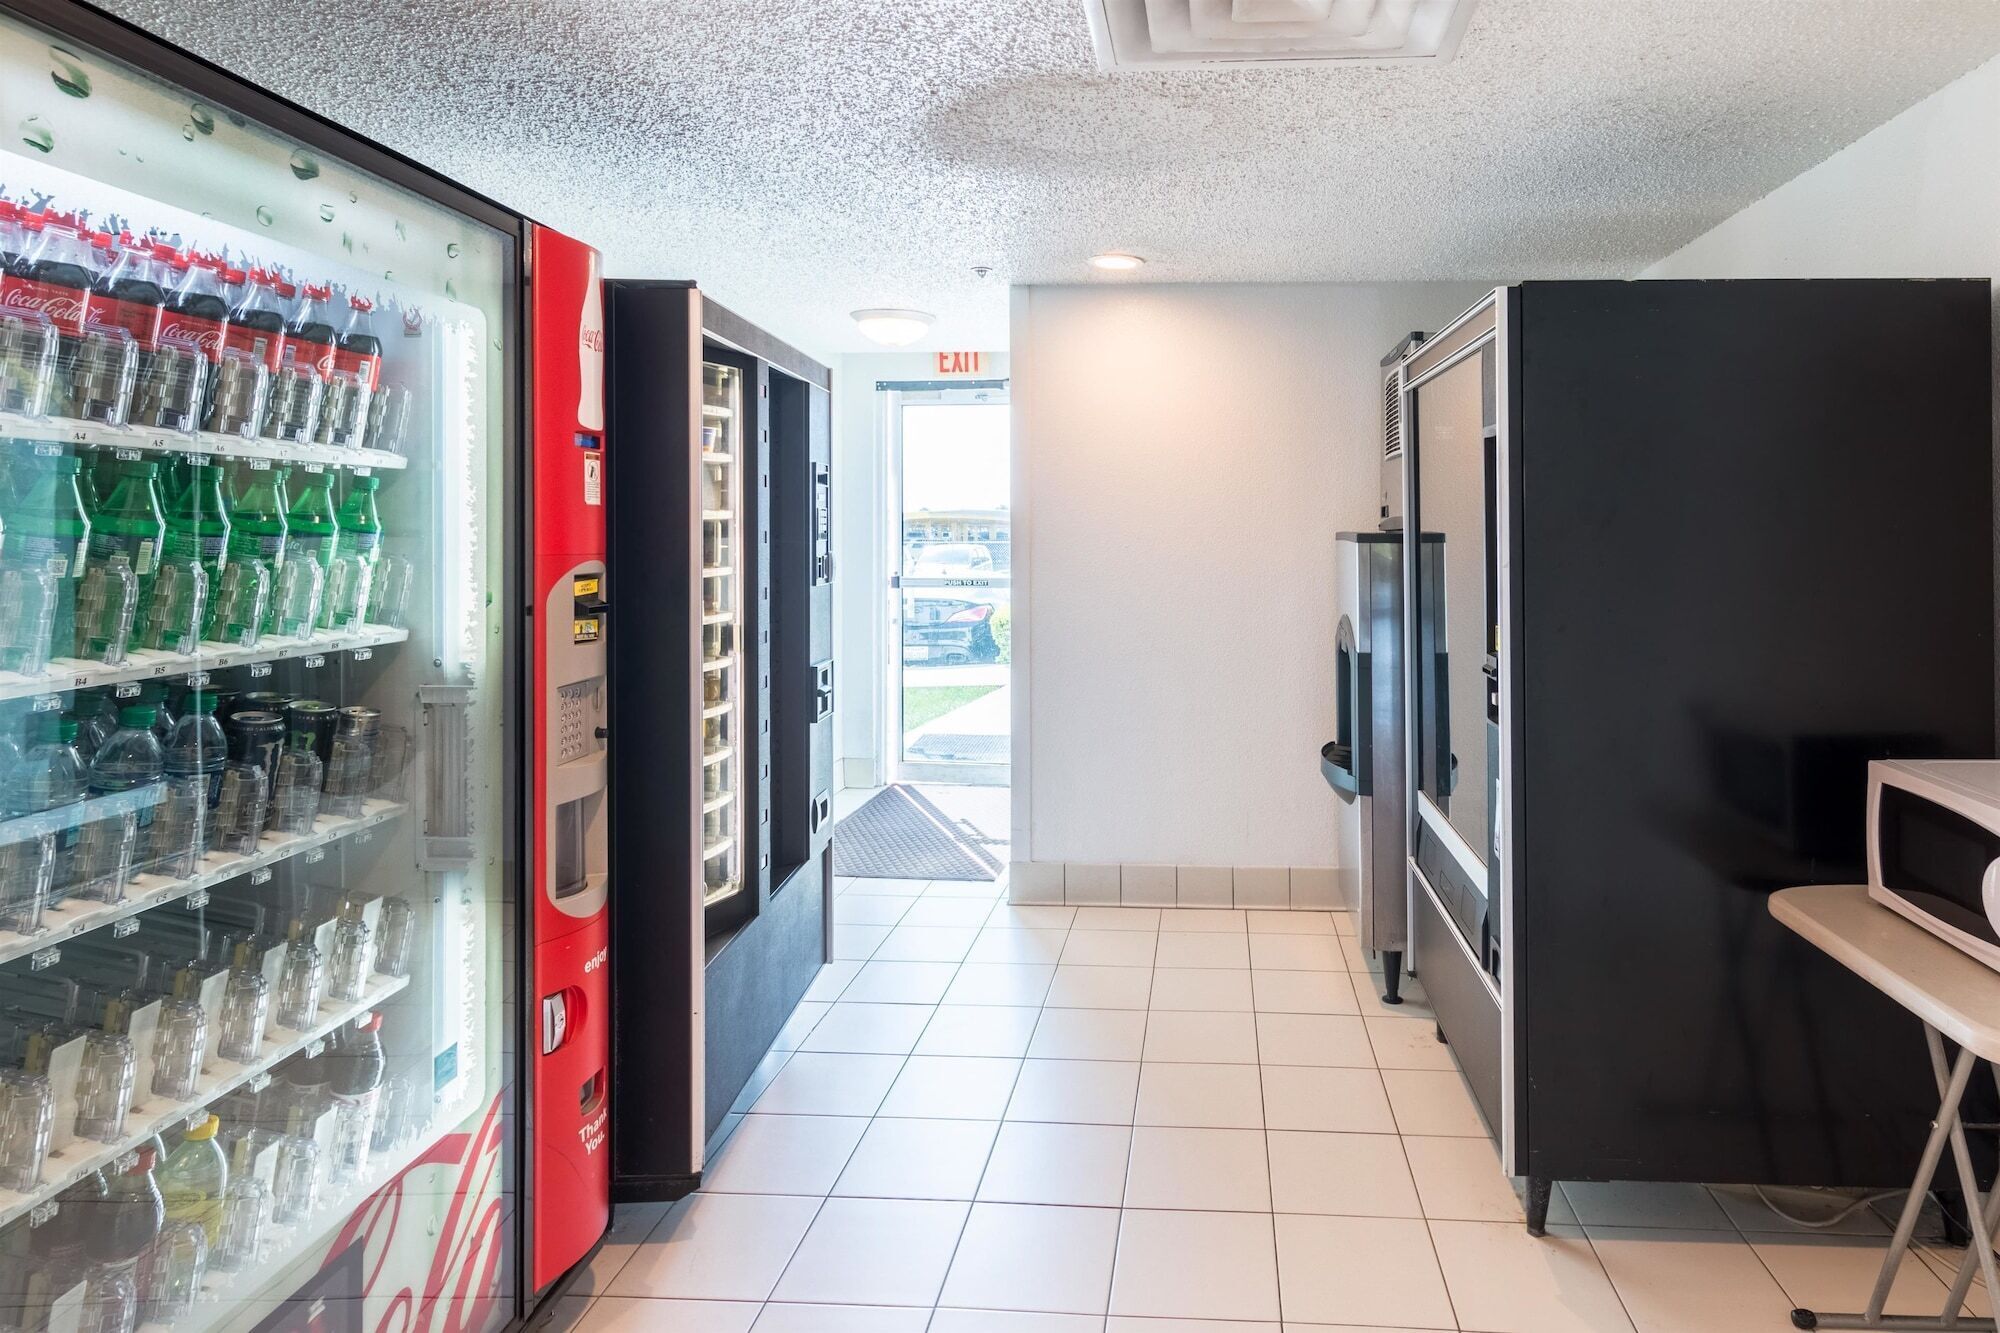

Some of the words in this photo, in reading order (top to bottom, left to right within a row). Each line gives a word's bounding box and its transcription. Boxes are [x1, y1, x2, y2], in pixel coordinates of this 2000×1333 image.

[73, 432, 86, 440] A4
[152, 439, 164, 447] A5
[215, 444, 225, 452] A6
[218, 658, 228, 666] B6
[154, 666, 165, 675] B5
[74, 677, 87, 686] B4
[156, 892, 168, 903] C5
[72, 923, 85, 935] C4
[584, 946, 608, 974] enjoy
[578, 1107, 608, 1143] Thank
[585, 1130, 605, 1156] You.
